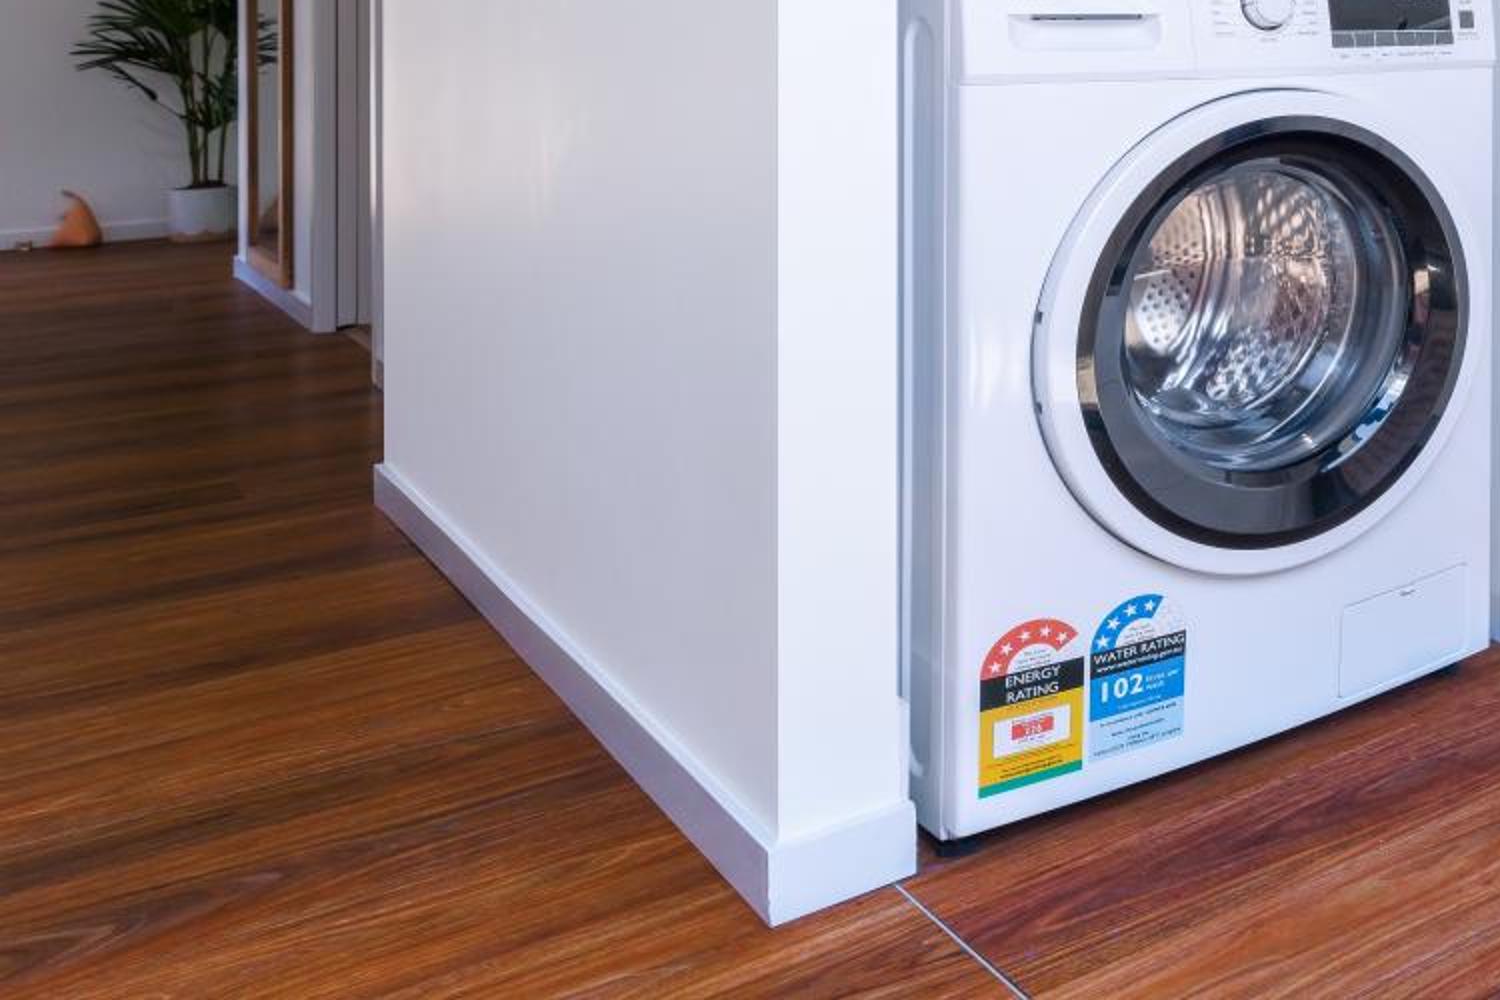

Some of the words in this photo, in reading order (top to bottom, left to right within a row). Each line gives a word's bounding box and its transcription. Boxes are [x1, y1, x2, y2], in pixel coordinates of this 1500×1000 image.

[1093, 646, 1138, 665] WATER
[1140, 633, 1185, 653] RATING
[1004, 664, 1061, 689] ENERGY
[1100, 673, 1144, 704] 102
[1006, 681, 1060, 704] RATING
